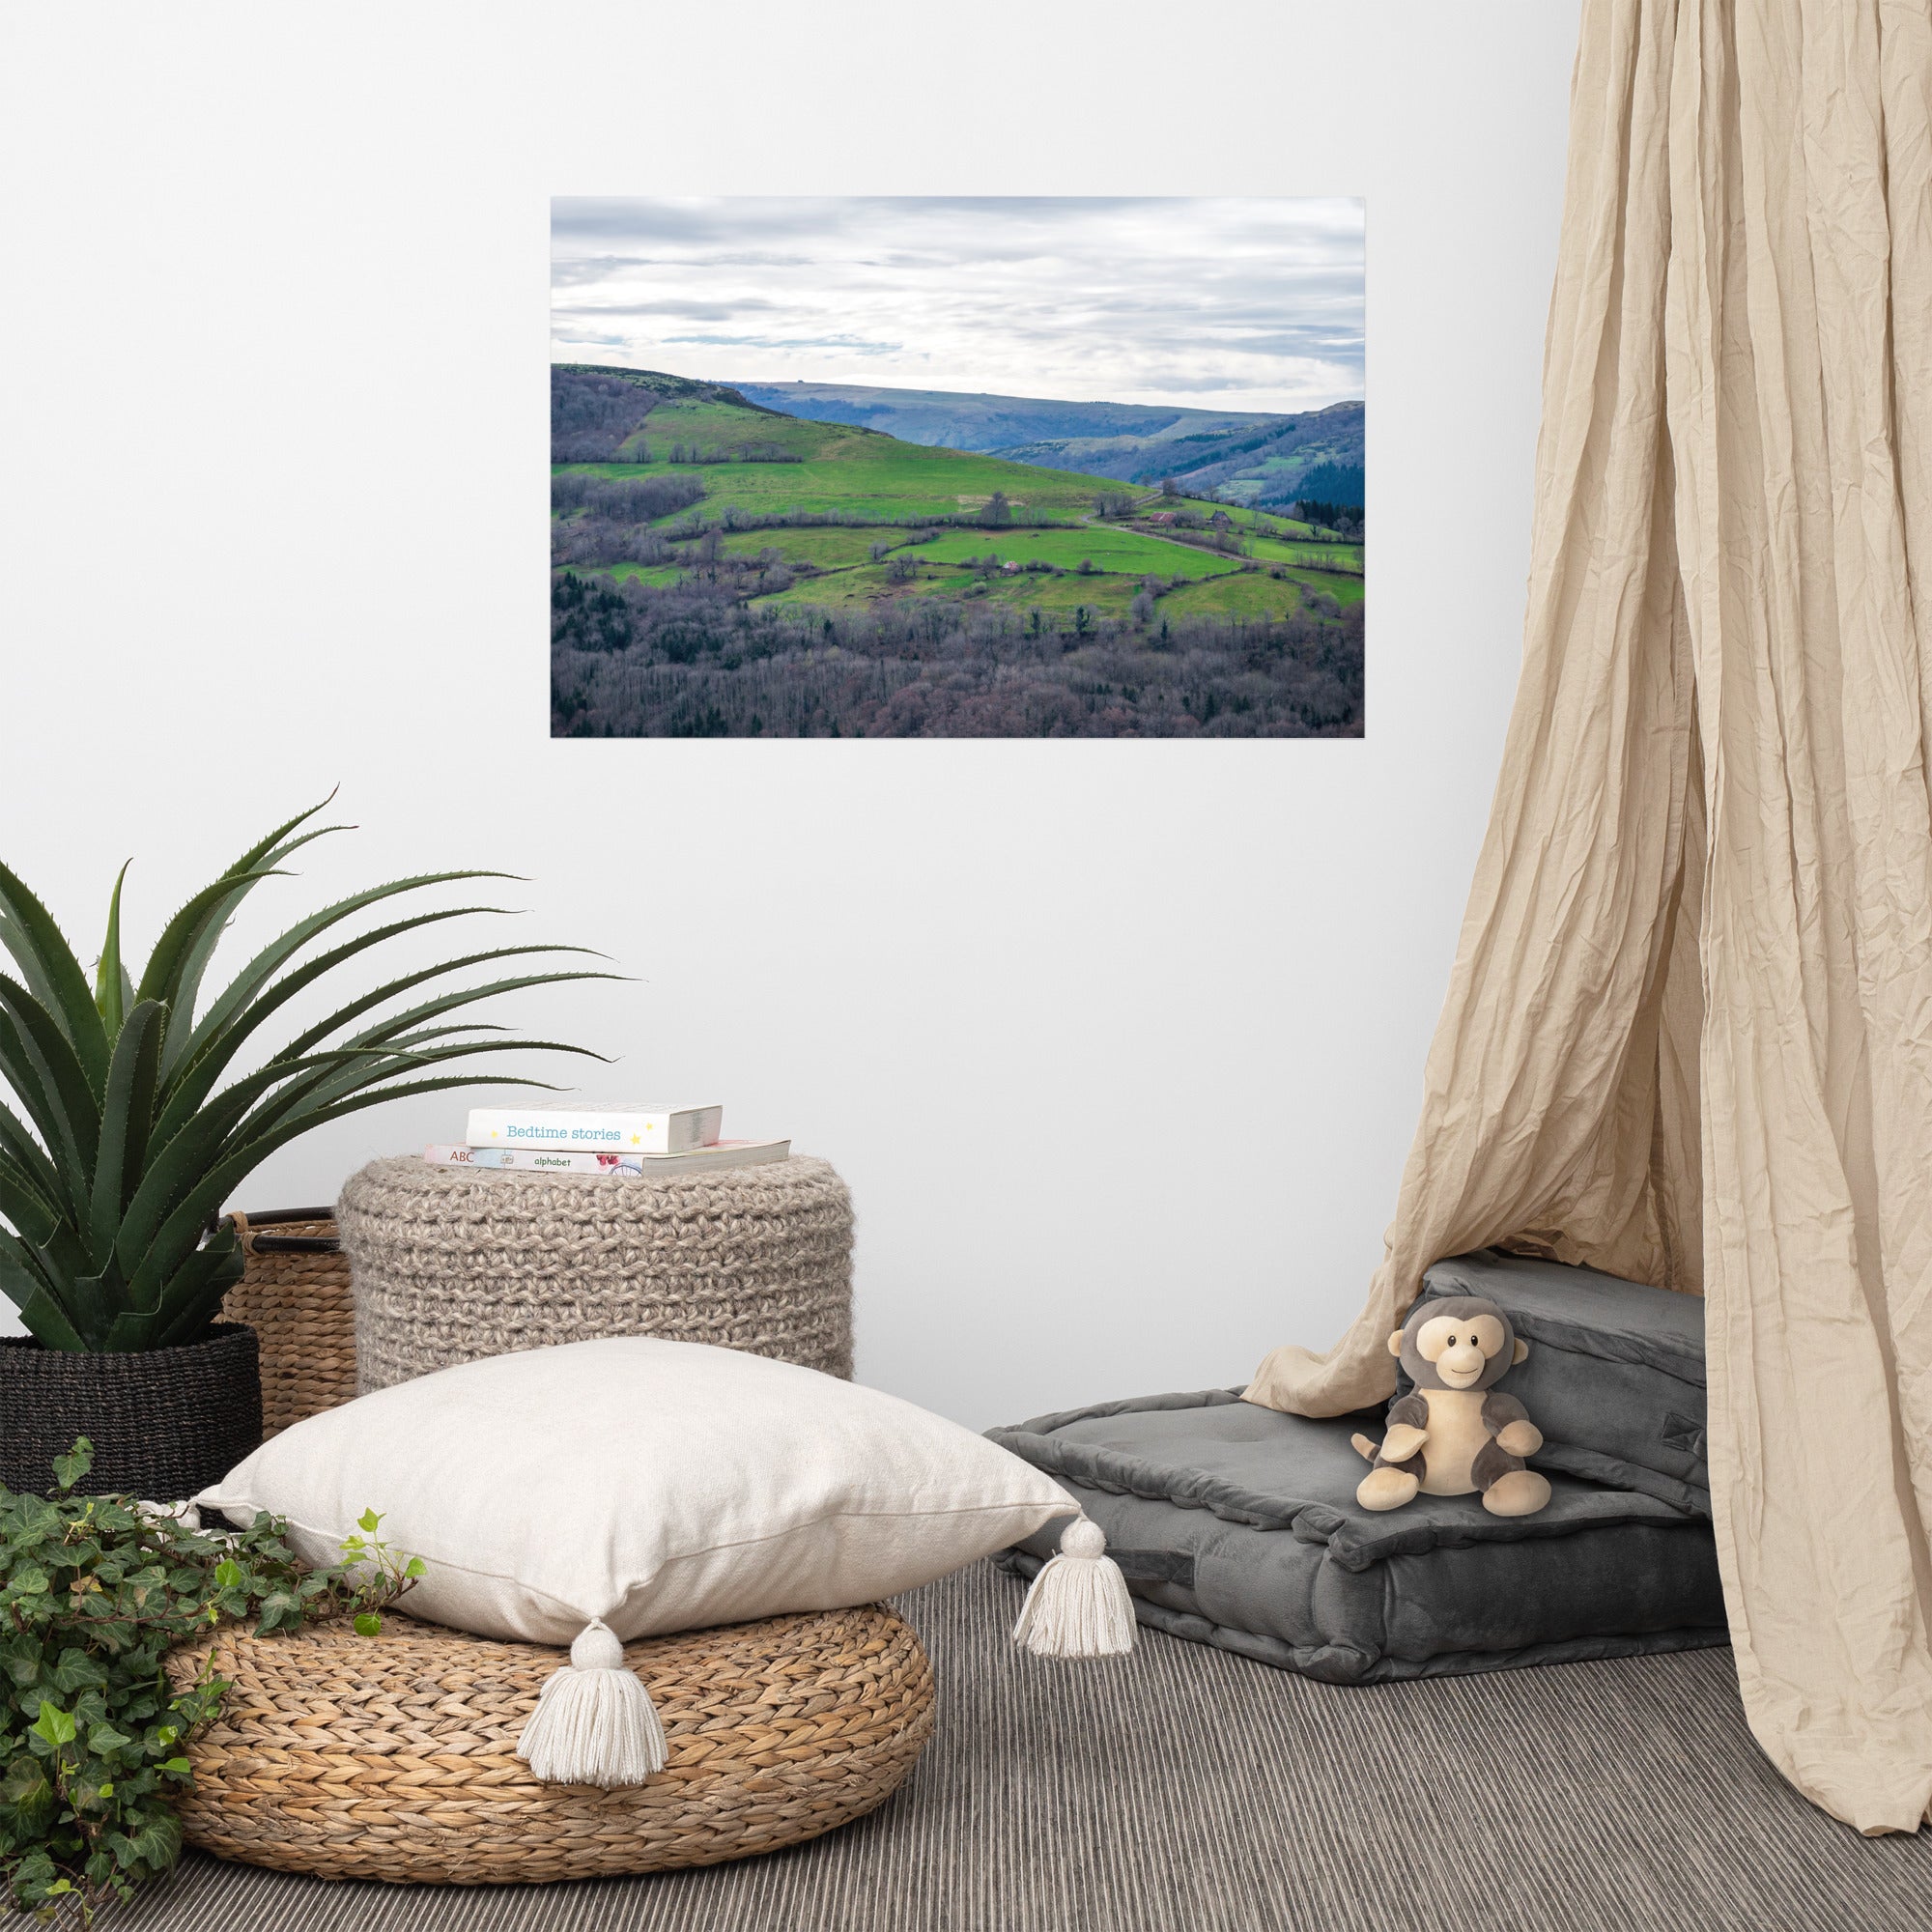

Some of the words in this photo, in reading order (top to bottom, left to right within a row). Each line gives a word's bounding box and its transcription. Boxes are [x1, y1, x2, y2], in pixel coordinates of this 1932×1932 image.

[507, 1125, 567, 1138] Bedtime
[572, 1127, 621, 1140] stories
[449, 1151, 475, 1163] ABC
[534, 1156, 571, 1167] alphabet
